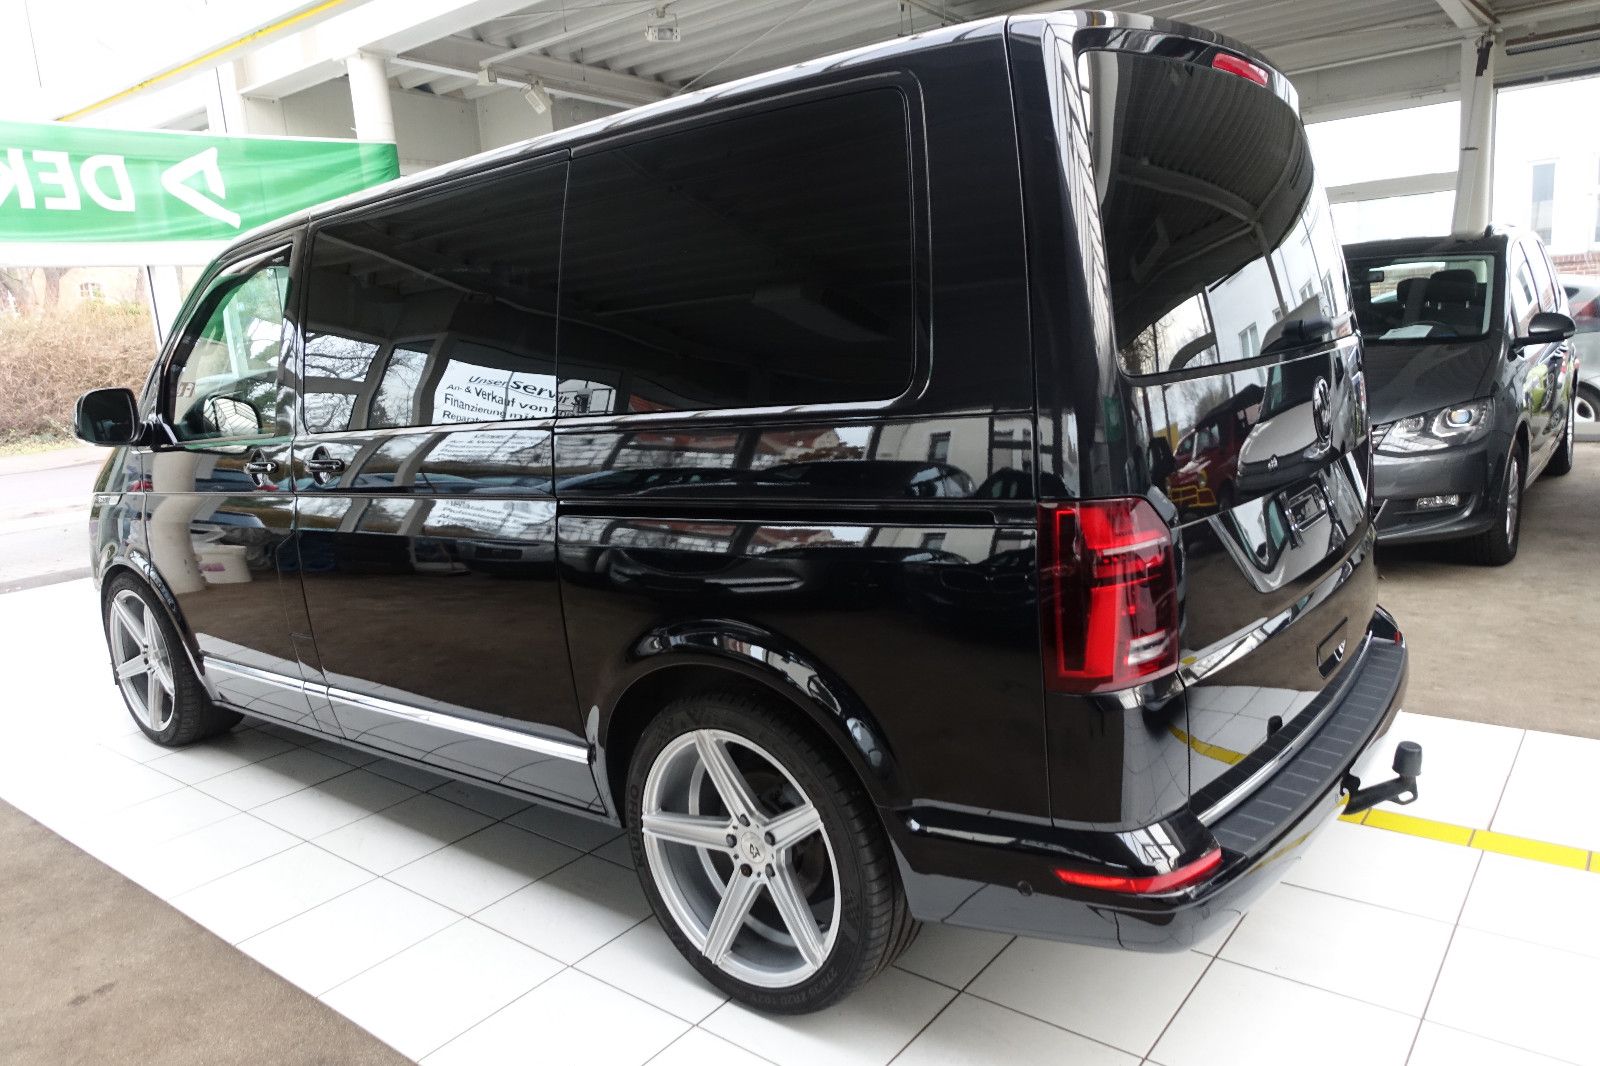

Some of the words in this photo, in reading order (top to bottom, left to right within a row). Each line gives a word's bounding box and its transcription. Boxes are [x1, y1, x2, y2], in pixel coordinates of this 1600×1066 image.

[444, 392, 507, 418] Finanzierung
[464, 386, 472, 394] &
[475, 386, 516, 408] Verkauf
[519, 400, 548, 412] von
